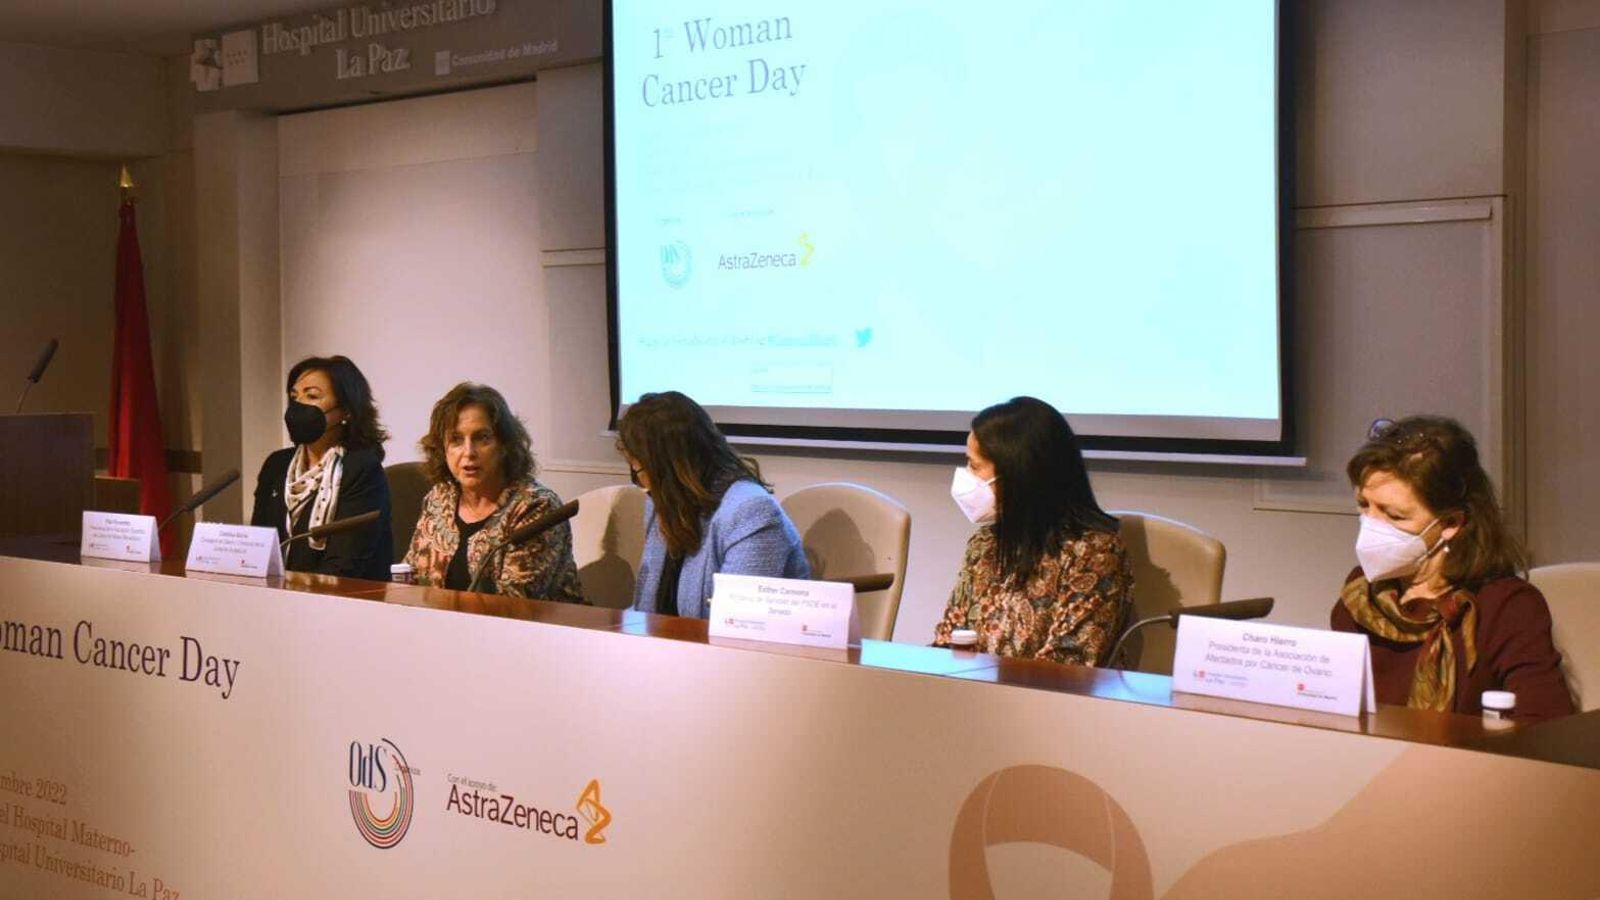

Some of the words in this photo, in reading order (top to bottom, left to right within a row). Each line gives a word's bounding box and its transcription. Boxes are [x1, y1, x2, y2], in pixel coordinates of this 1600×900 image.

[262, 9, 348, 56] Hospital
[522, 39, 558, 57] Madrid
[683, 16, 793, 54] Woman
[336, 48, 362, 80] La
[642, 74, 738, 107] Cancer
[746, 57, 807, 97] Day
[717, 251, 797, 270] AstraZeneca
[1208, 640, 1250, 654] Presidenta
[1252, 646, 1262, 655] de
[1319, 655, 1330, 664] de
[1242, 632, 1268, 643] Charo
[0, 620, 64, 660] man
[73, 620, 170, 677] Cancer
[179, 635, 240, 700] Day
[36, 778, 67, 805] 2022
[446, 783, 579, 841] AstraZeneca
[13, 805, 68, 840] Hospital
[71, 819, 136, 858] Materno-
[35, 845, 125, 893] Universitario
[128, 871, 148, 898] La
